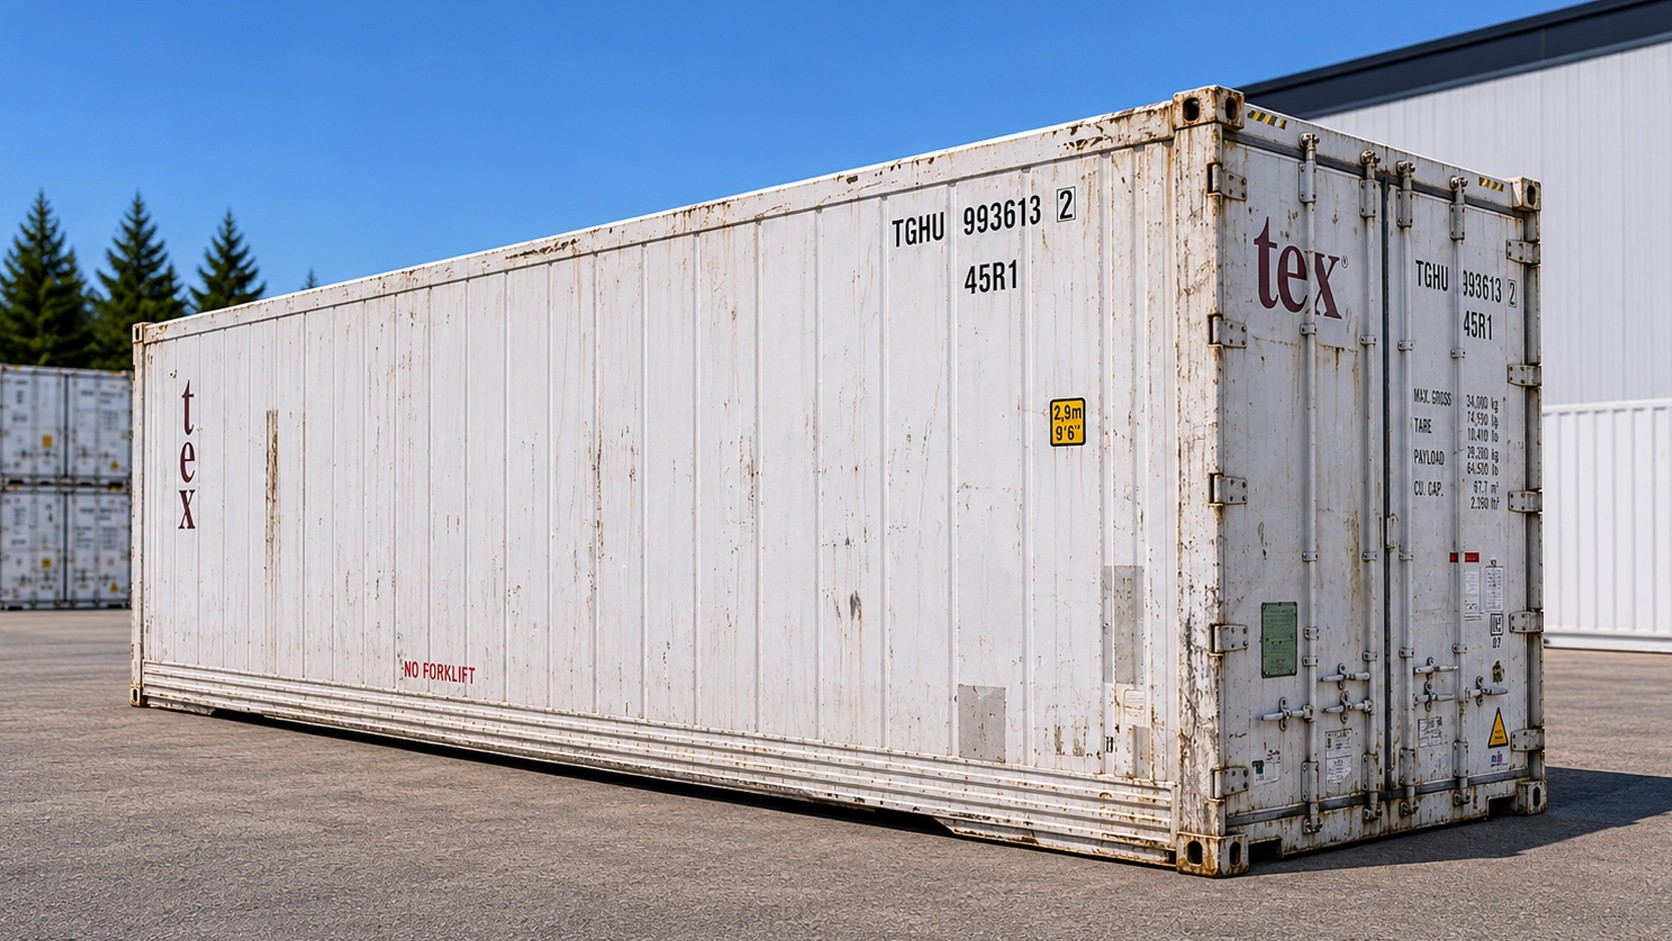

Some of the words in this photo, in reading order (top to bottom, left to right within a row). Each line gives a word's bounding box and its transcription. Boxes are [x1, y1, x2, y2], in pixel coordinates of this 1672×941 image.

[892, 212, 944, 247] TGHU
[963, 195, 1041, 236] 993613
[1059, 189, 1074, 220] 2
[964, 259, 1017, 294] 45R1
[1253, 216, 1342, 319] tex
[1415, 259, 1448, 291] TGHU
[1508, 281, 1516, 306] 2
[1464, 310, 1492, 340] 45R1
[1054, 404, 1082, 422] 2,9m
[1414, 417, 1432, 433] TARE
[178, 379, 196, 529] tex
[1414, 449, 1445, 465] PAYLOAD
[404, 661, 419, 678] NO
[423, 662, 476, 684] FORKLIFT
